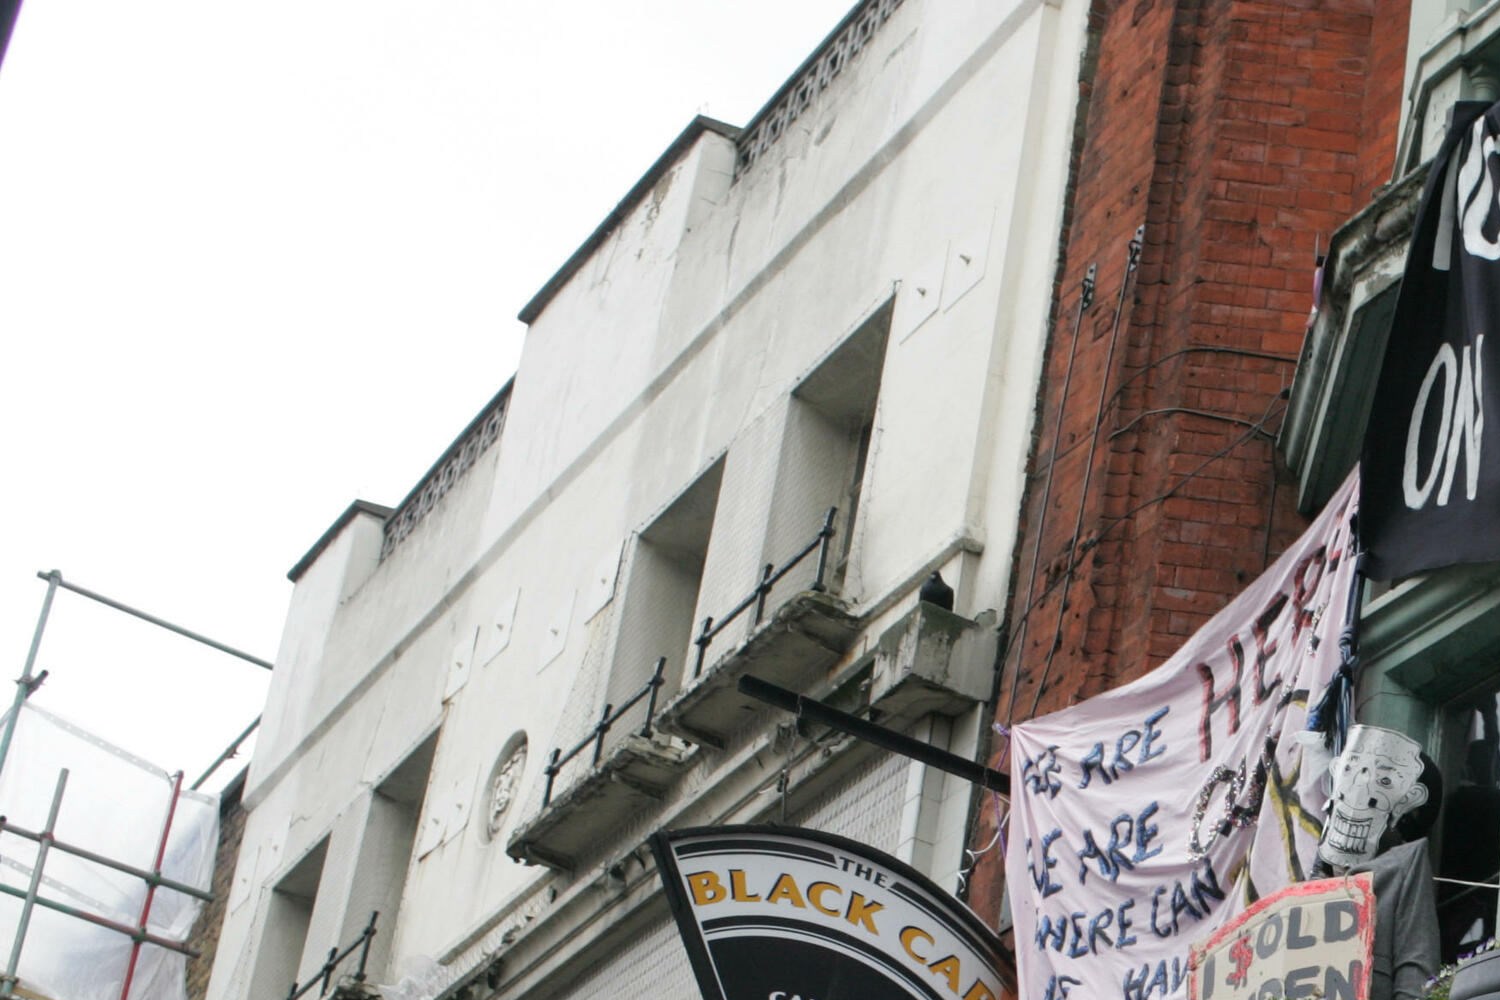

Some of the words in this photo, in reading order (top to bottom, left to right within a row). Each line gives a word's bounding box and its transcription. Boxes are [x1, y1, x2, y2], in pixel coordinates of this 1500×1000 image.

[1403, 334, 1484, 510] ON
[1078, 705, 1170, 789] ARE
[838, 855, 889, 890] THE
[1078, 801, 1163, 886] ARE
[685, 869, 885, 937] BLACK
[1151, 856, 1225, 938] CAN
